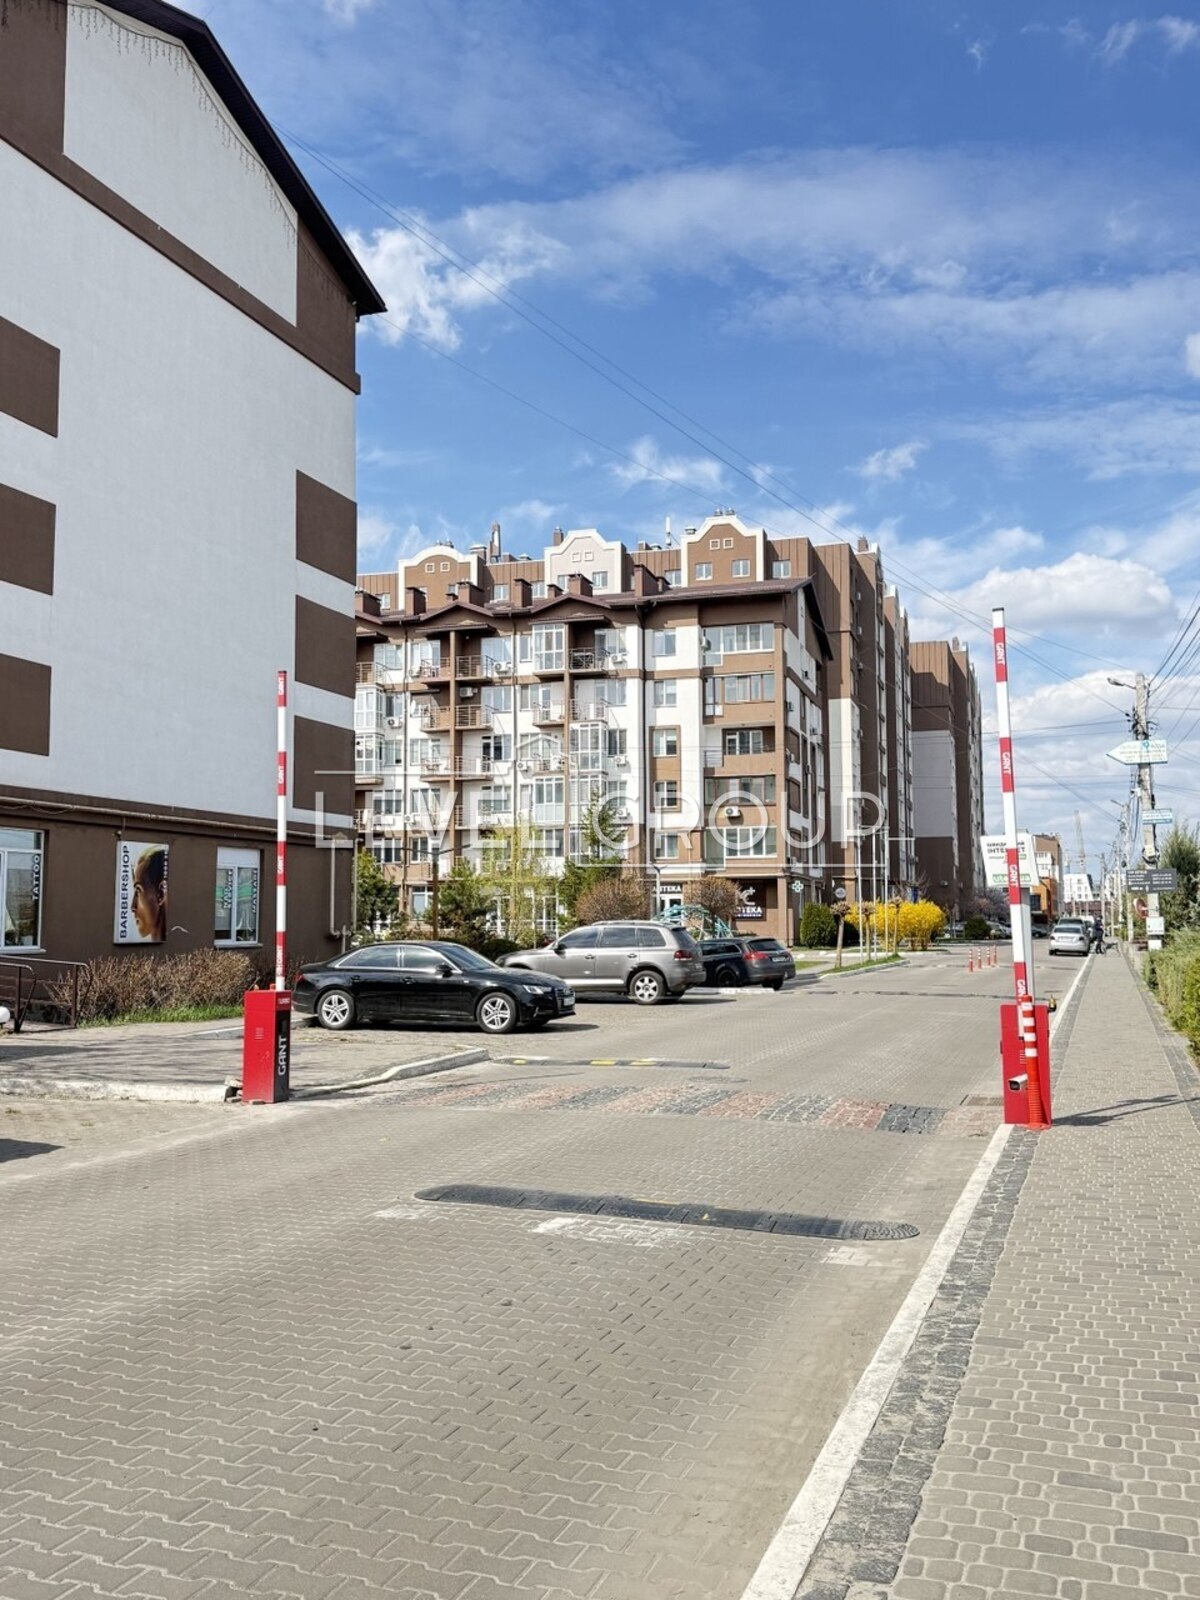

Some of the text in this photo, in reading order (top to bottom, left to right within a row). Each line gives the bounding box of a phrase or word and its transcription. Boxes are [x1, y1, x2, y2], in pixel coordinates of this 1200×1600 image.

[996, 641, 1005, 666] GANT
[1002, 751, 1011, 775] GANT
[32, 855, 40, 901] TATTOO
[120, 845, 130, 939] BARBERSHOP
[1009, 864, 1018, 888] GANT
[277, 1035, 287, 1076] GANT
